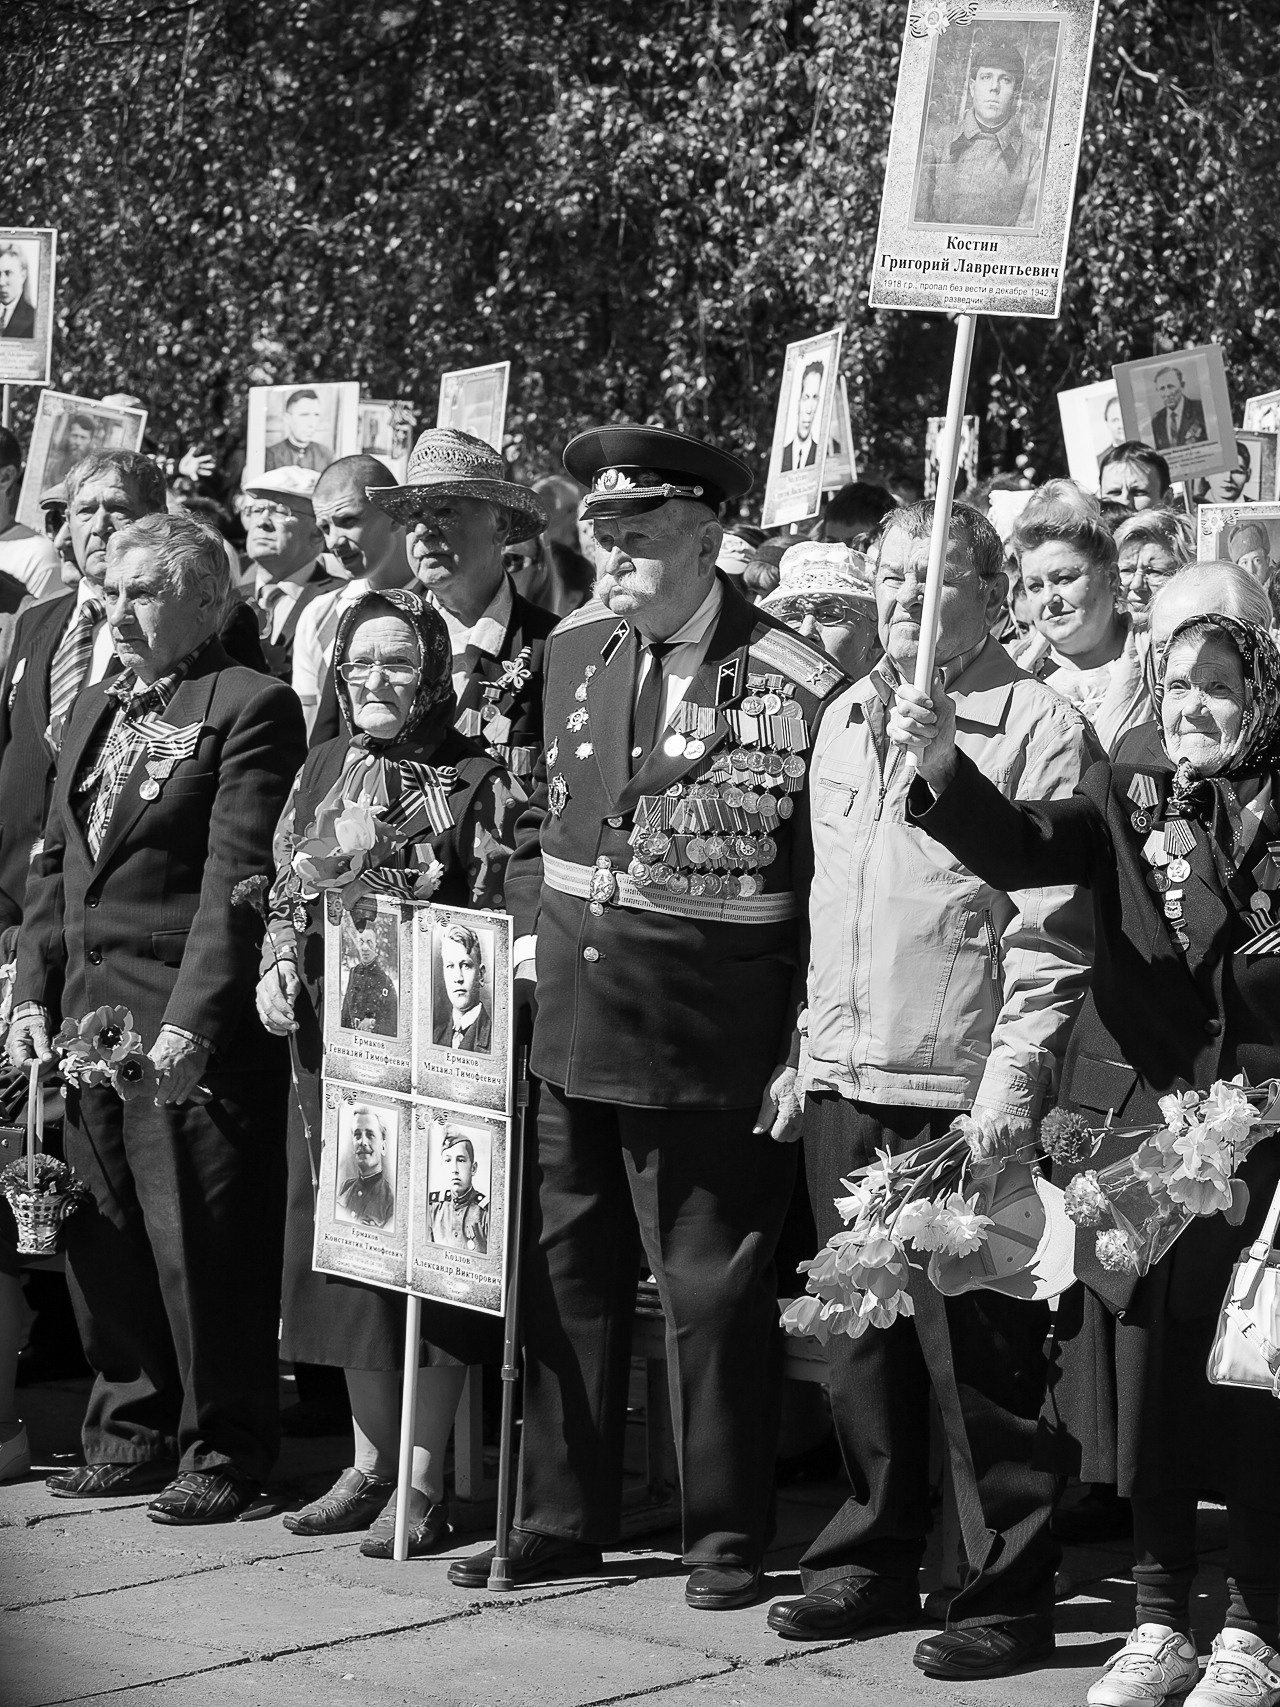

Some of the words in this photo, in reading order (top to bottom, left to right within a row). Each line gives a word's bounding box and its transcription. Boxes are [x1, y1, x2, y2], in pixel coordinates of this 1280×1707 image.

[946, 236, 999, 252] Костин
[880, 254, 949, 273] Григорий
[953, 258, 1059, 278] Лаврентьевич
[883, 280, 902, 288] 1918
[919, 282, 948, 293] пропал
[950, 282, 963, 292] без
[964, 285, 987, 293] вести
[995, 286, 1028, 297] декабре
[943, 295, 984, 305] разведчик
[354, 1035, 386, 1050] Ермаков
[329, 1043, 363, 1058] Геннадий
[365, 1050, 410, 1067] Тимофеевич
[446, 1052, 479, 1067] Ермаков
[423, 1061, 453, 1075] Михаил
[455, 1067, 502, 1085] Тимофеевич
[351, 1227, 379, 1241] Ермаков
[324, 1233, 363, 1248] Константин
[365, 1242, 404, 1259] Тимофеевич
[444, 1250, 471, 1265] Козлов
[414, 1258, 454, 1276] Александр
[455, 1267, 502, 1286] Викторович
